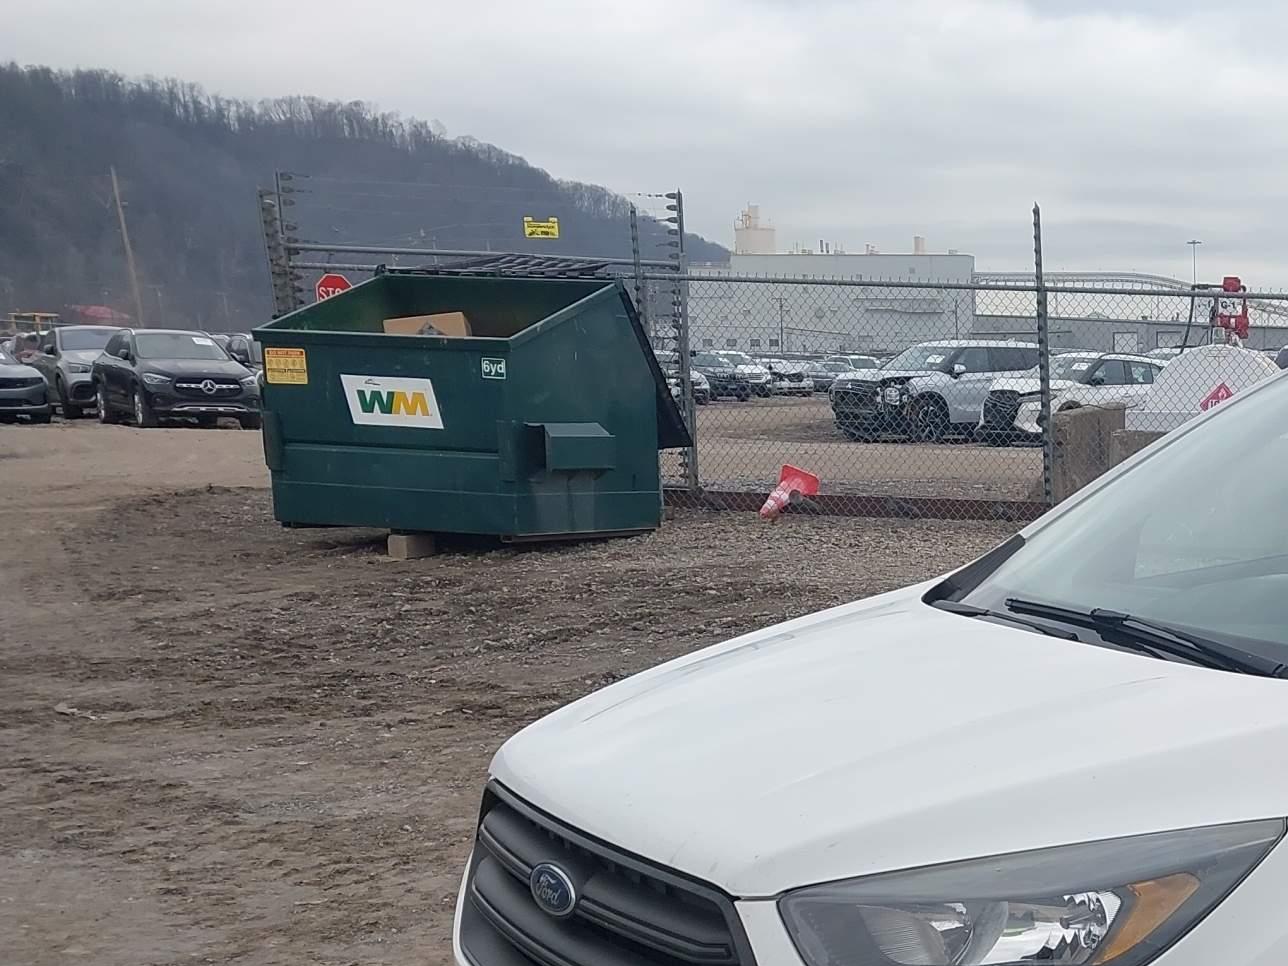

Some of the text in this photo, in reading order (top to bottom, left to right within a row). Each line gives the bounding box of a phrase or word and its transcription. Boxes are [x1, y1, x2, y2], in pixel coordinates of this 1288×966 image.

[483, 360, 505, 376] 6yd
[356, 389, 430, 416] WM
[535, 873, 561, 905] Ford
